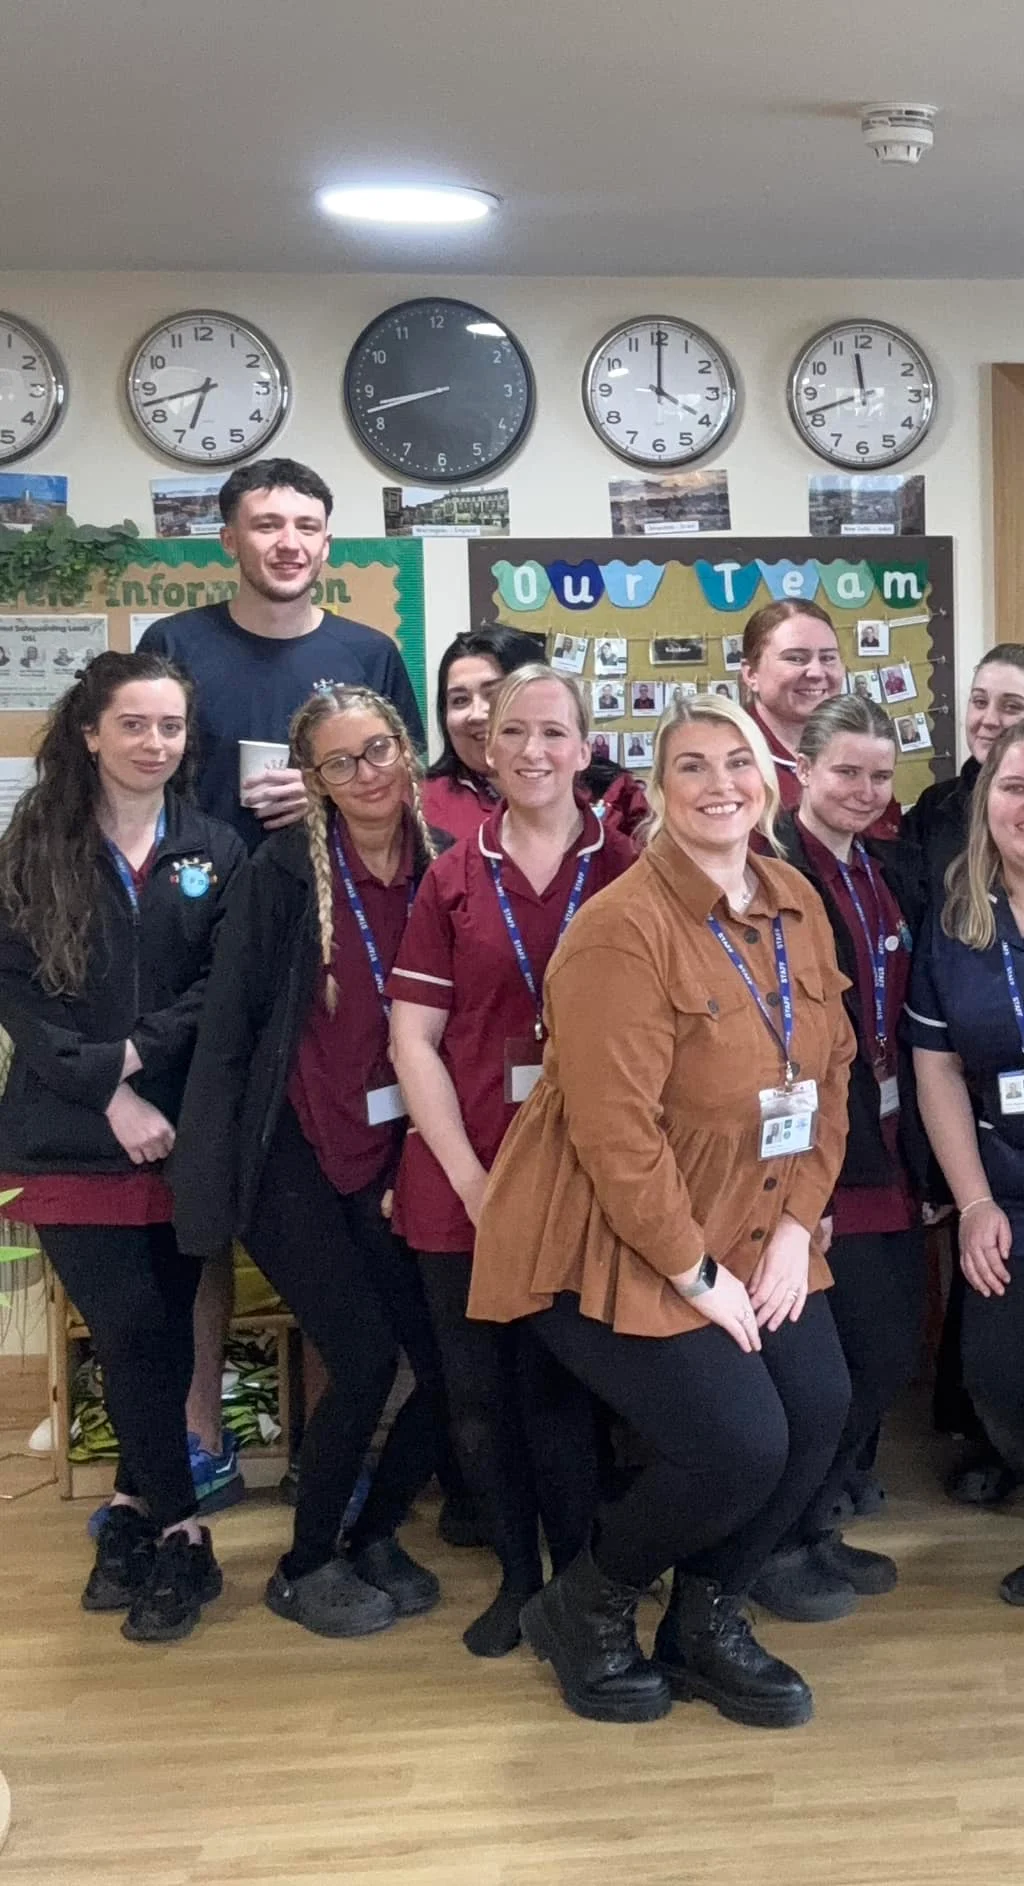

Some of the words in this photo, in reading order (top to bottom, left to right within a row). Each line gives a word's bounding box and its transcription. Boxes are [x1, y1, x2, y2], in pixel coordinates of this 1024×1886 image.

[430, 316, 444, 328] 12
[194, 326, 214, 342] 12
[396, 326, 409, 340] 11
[650, 331, 669, 346] 12
[171, 334, 182, 348] 11
[628, 338, 638, 352] 11
[833, 340, 844, 356] 11
[854, 335, 872, 350] 12
[22, 356, 36, 370] 2
[150, 355, 166, 370] 10
[245, 354, 260, 368] 2
[372, 350, 386, 364] 10
[493, 350, 502, 364] 2
[607, 358, 622, 372] 10
[698, 360, 712, 374] 2
[812, 362, 827, 376] 10
[900, 362, 914, 377] 2
[29, 384, 46, 398] 3
[142, 382, 157, 396] 9
[255, 381, 270, 396] 3
[364, 384, 374, 398] 9
[503, 384, 512, 397] 3
[598, 384, 612, 398] 9
[705, 386, 720, 401] 3
[804, 386, 818, 400] 9
[908, 390, 922, 404] 3
[21, 411, 36, 426] 4
[152, 409, 168, 424] 8
[248, 408, 264, 424] 4
[606, 410, 622, 424] 8
[698, 414, 712, 428] 4
[810, 414, 826, 428] 8
[900, 416, 914, 430] 4
[376, 417, 386, 430] 8
[498, 417, 506, 430] 4
[0, 430, 16, 444] 5
[174, 429, 186, 444] 7
[229, 428, 245, 443] 5
[626, 430, 638, 444] 7
[679, 432, 694, 446] 5
[830, 434, 842, 448] 7
[882, 434, 896, 448] 5
[202, 436, 216, 450] 6
[402, 442, 412, 456] 7
[472, 443, 482, 456] 5
[652, 438, 666, 452] 6
[856, 441, 870, 455] 6
[438, 452, 447, 466] 6
[513, 566, 642, 603] Our
[713, 563, 923, 603] Team
[504, 908, 516, 928] STAFF
[718, 932, 734, 952] STAFF
[514, 940, 526, 960] STAFF
[779, 962, 788, 984] STAFF
[782, 996, 792, 1018] STAFF
[1012, 996, 1024, 1016] STAFF
